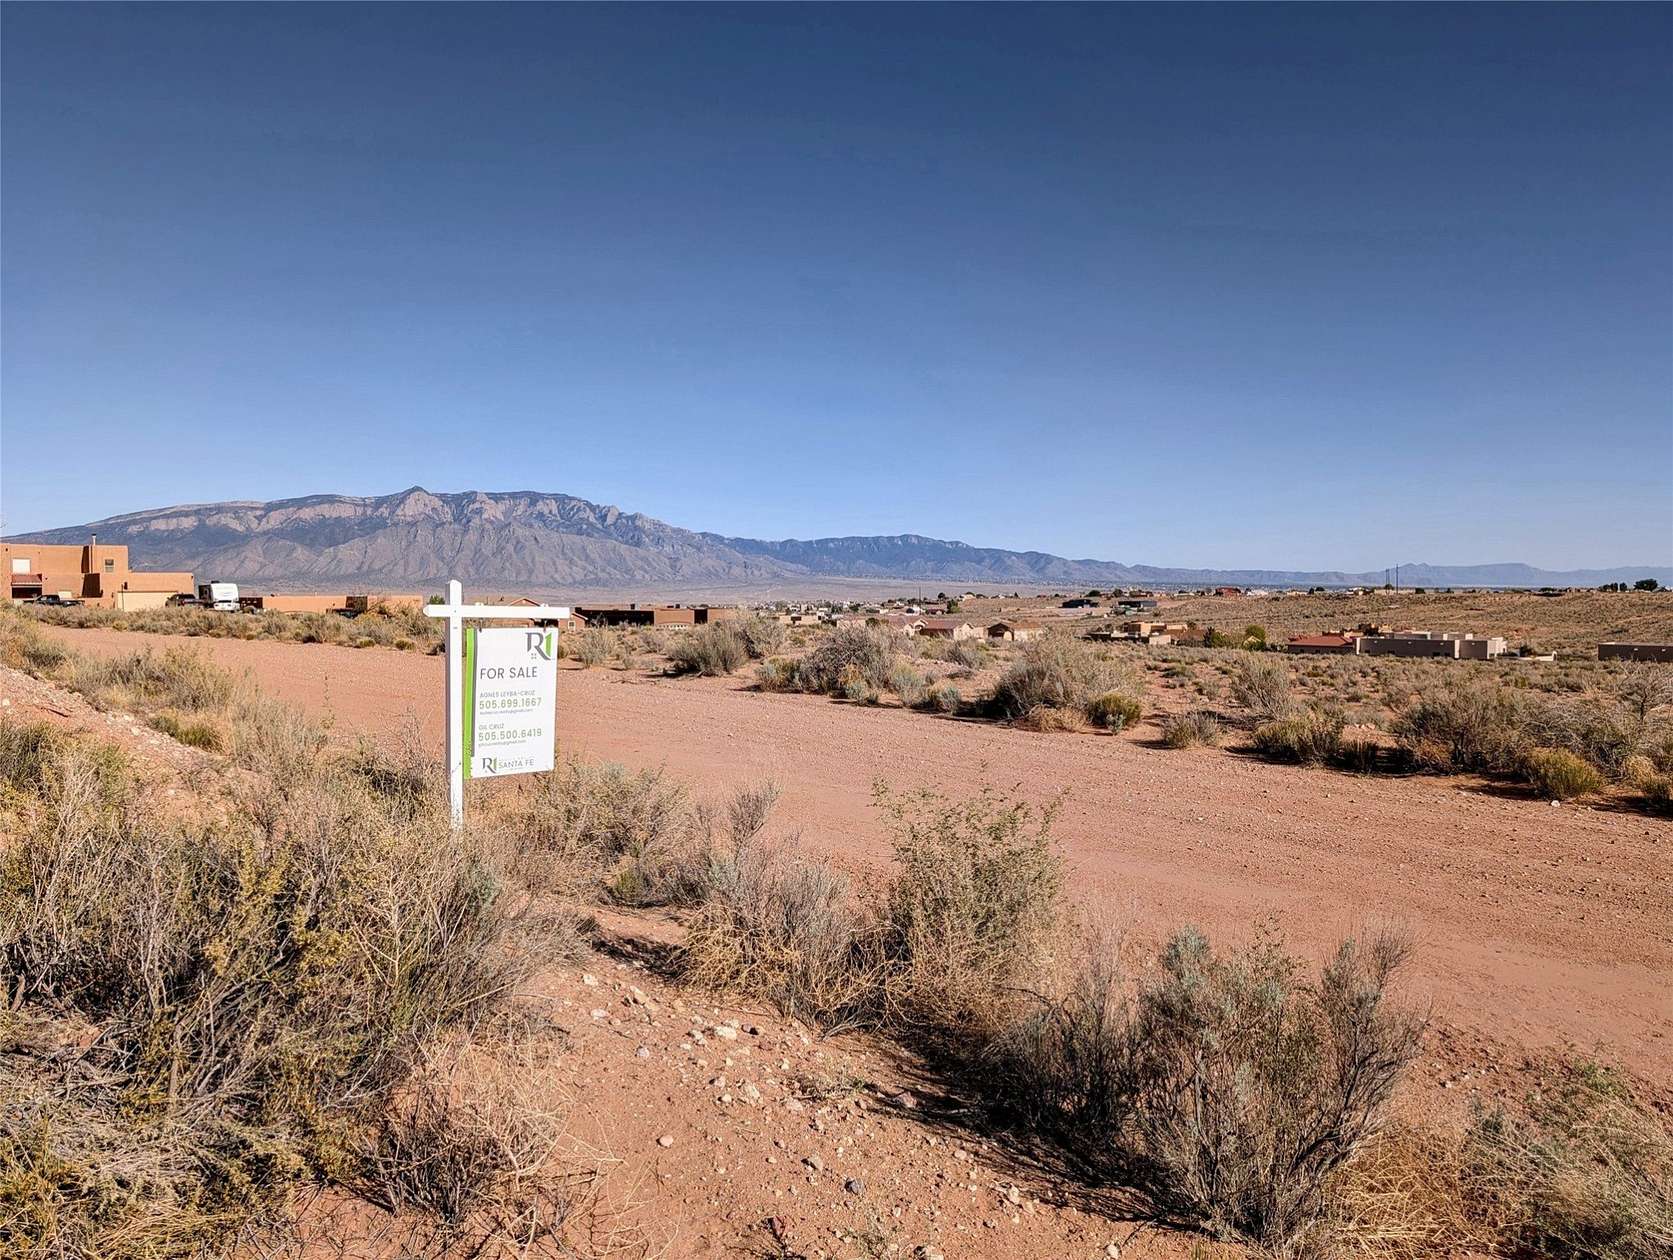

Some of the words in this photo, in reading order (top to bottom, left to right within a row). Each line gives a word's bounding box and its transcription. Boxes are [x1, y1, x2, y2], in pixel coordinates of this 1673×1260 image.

[480, 667, 505, 680] FOR
[509, 666, 538, 679] SALE
[479, 697, 542, 710] 505.699.1667
[478, 728, 542, 741] 505.500.6419
[499, 760, 523, 769] SANTA
[525, 758, 535, 767] FE
